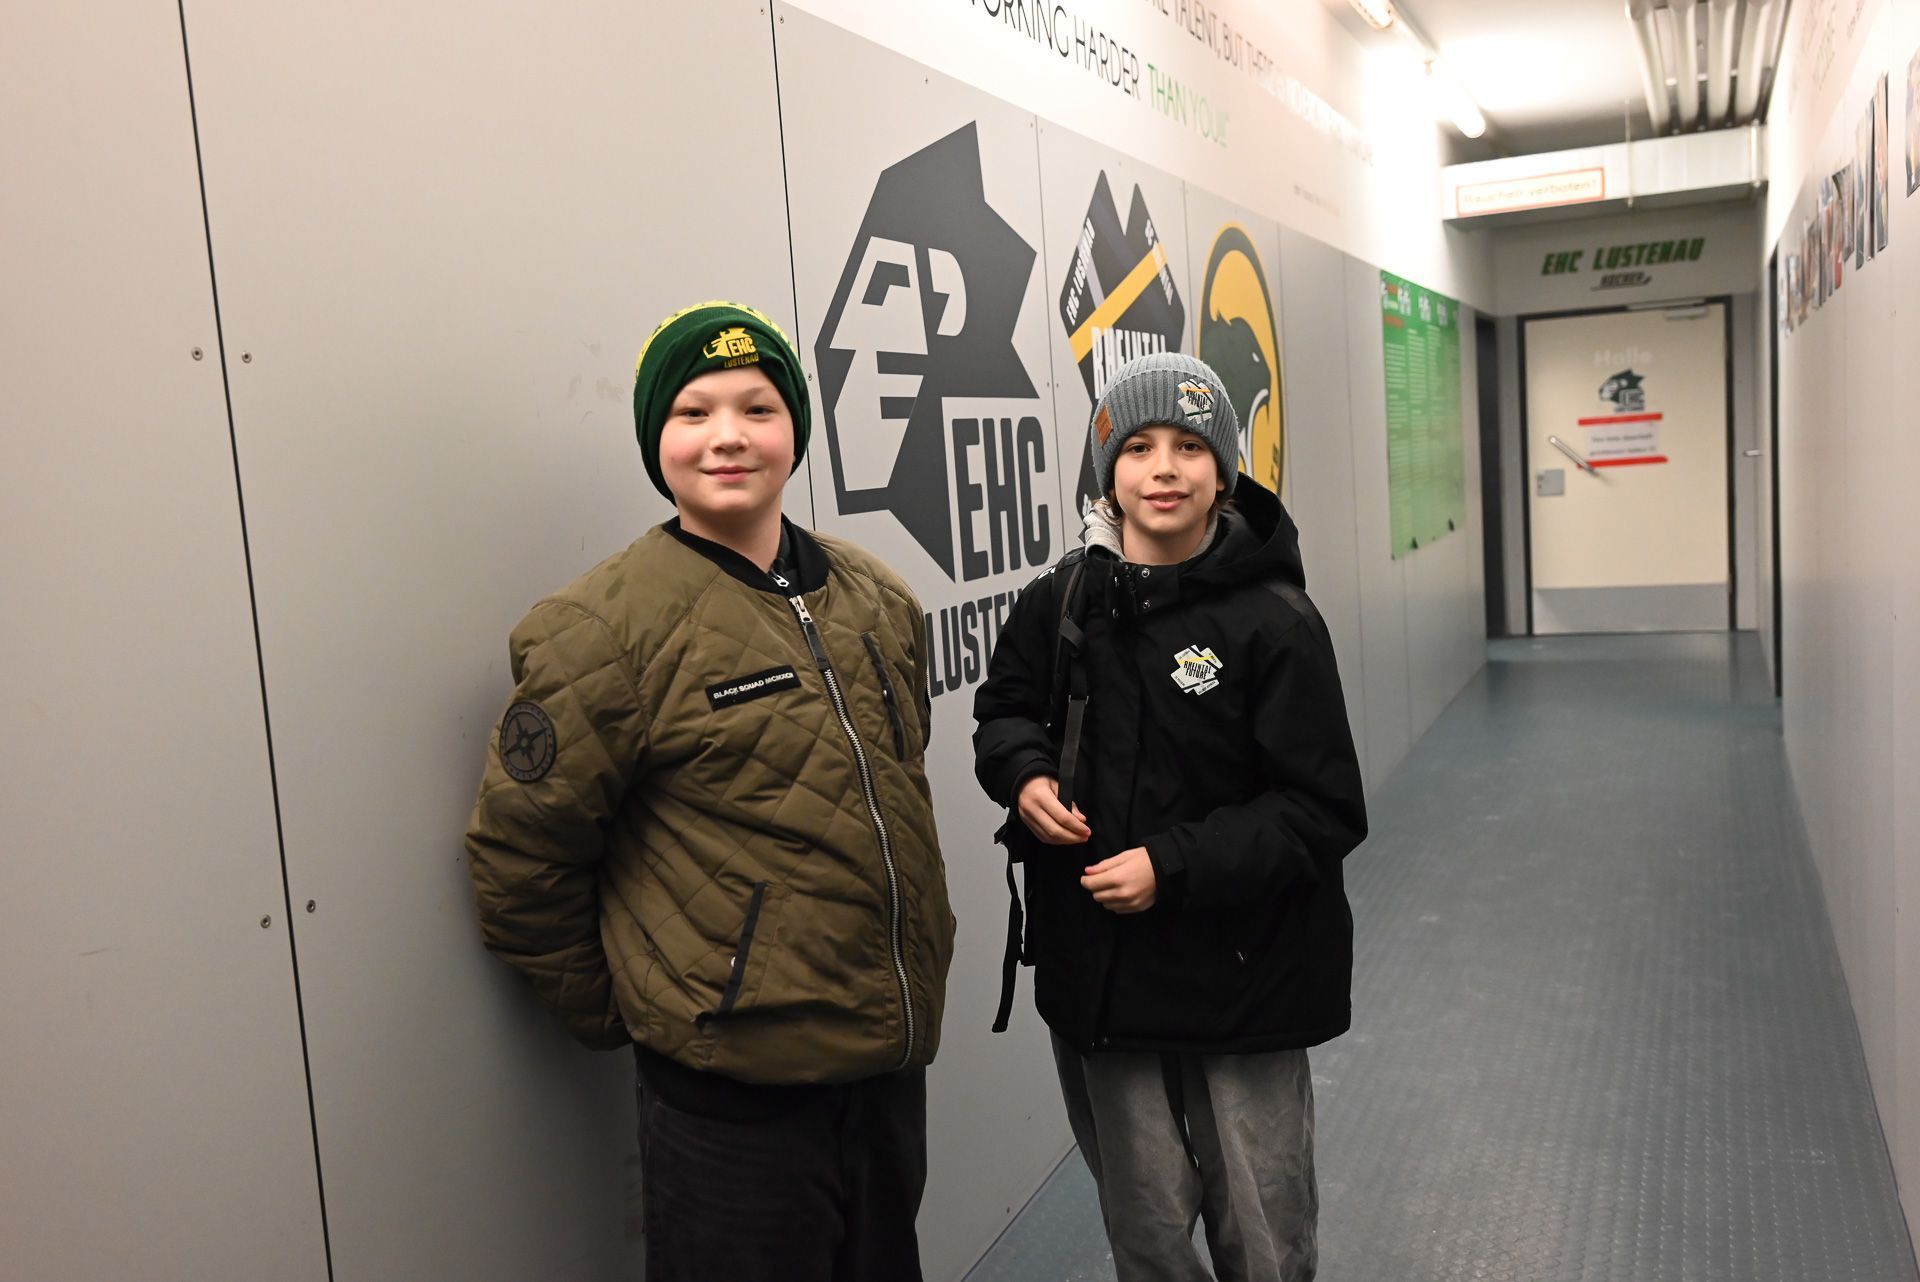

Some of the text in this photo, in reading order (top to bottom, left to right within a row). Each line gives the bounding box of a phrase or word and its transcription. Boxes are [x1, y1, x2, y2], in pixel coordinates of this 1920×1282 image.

[1074, 15, 1141, 100] HARDER
[1147, 63, 1187, 127] THAN
[1541, 237, 1705, 276] EHC LUSTENAU
[727, 337, 757, 357] EHC
[952, 416, 1050, 582] EHC
[925, 588, 1023, 698] LUST
[713, 686, 738, 699] BLACK
[738, 680, 764, 692] SQUAD
